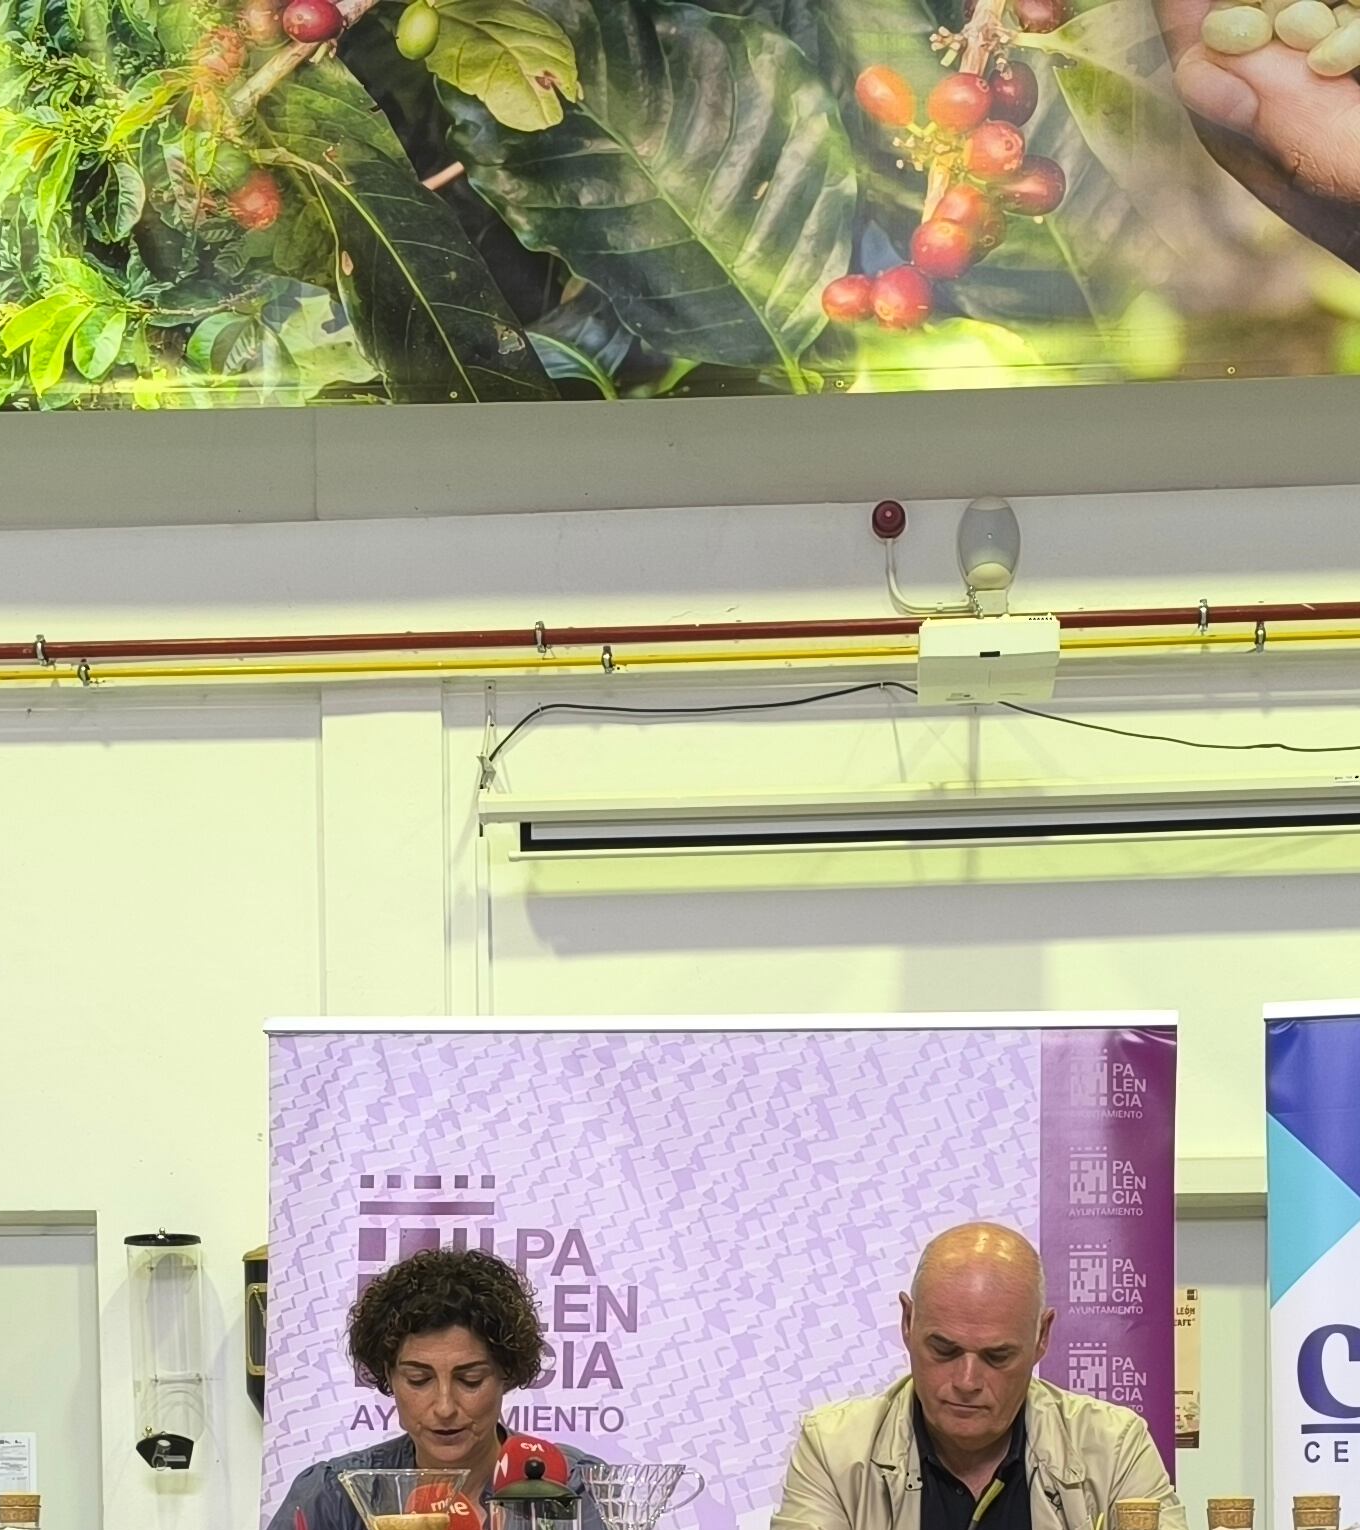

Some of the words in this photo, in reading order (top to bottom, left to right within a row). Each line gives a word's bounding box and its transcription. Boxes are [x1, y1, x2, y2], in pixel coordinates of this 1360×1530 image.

[1113, 1063, 1134, 1077] PA
[1113, 1078, 1146, 1092] LEN
[1112, 1093, 1142, 1107] CIA
[1113, 1160, 1134, 1174] PA
[1113, 1176, 1146, 1189] LEN
[1112, 1191, 1142, 1205] CIA
[1069, 1208, 1143, 1216] AYUNTAMIENTO
[516, 1228, 597, 1277] PA
[1113, 1259, 1135, 1272] PA
[1113, 1274, 1147, 1288] LEN
[1112, 1289, 1142, 1303] CIA
[1069, 1306, 1143, 1315] AYUNTAMIENTO
[1112, 1357, 1135, 1370] PA
[1112, 1372, 1147, 1386] LEN
[1112, 1387, 1142, 1401] CIA
